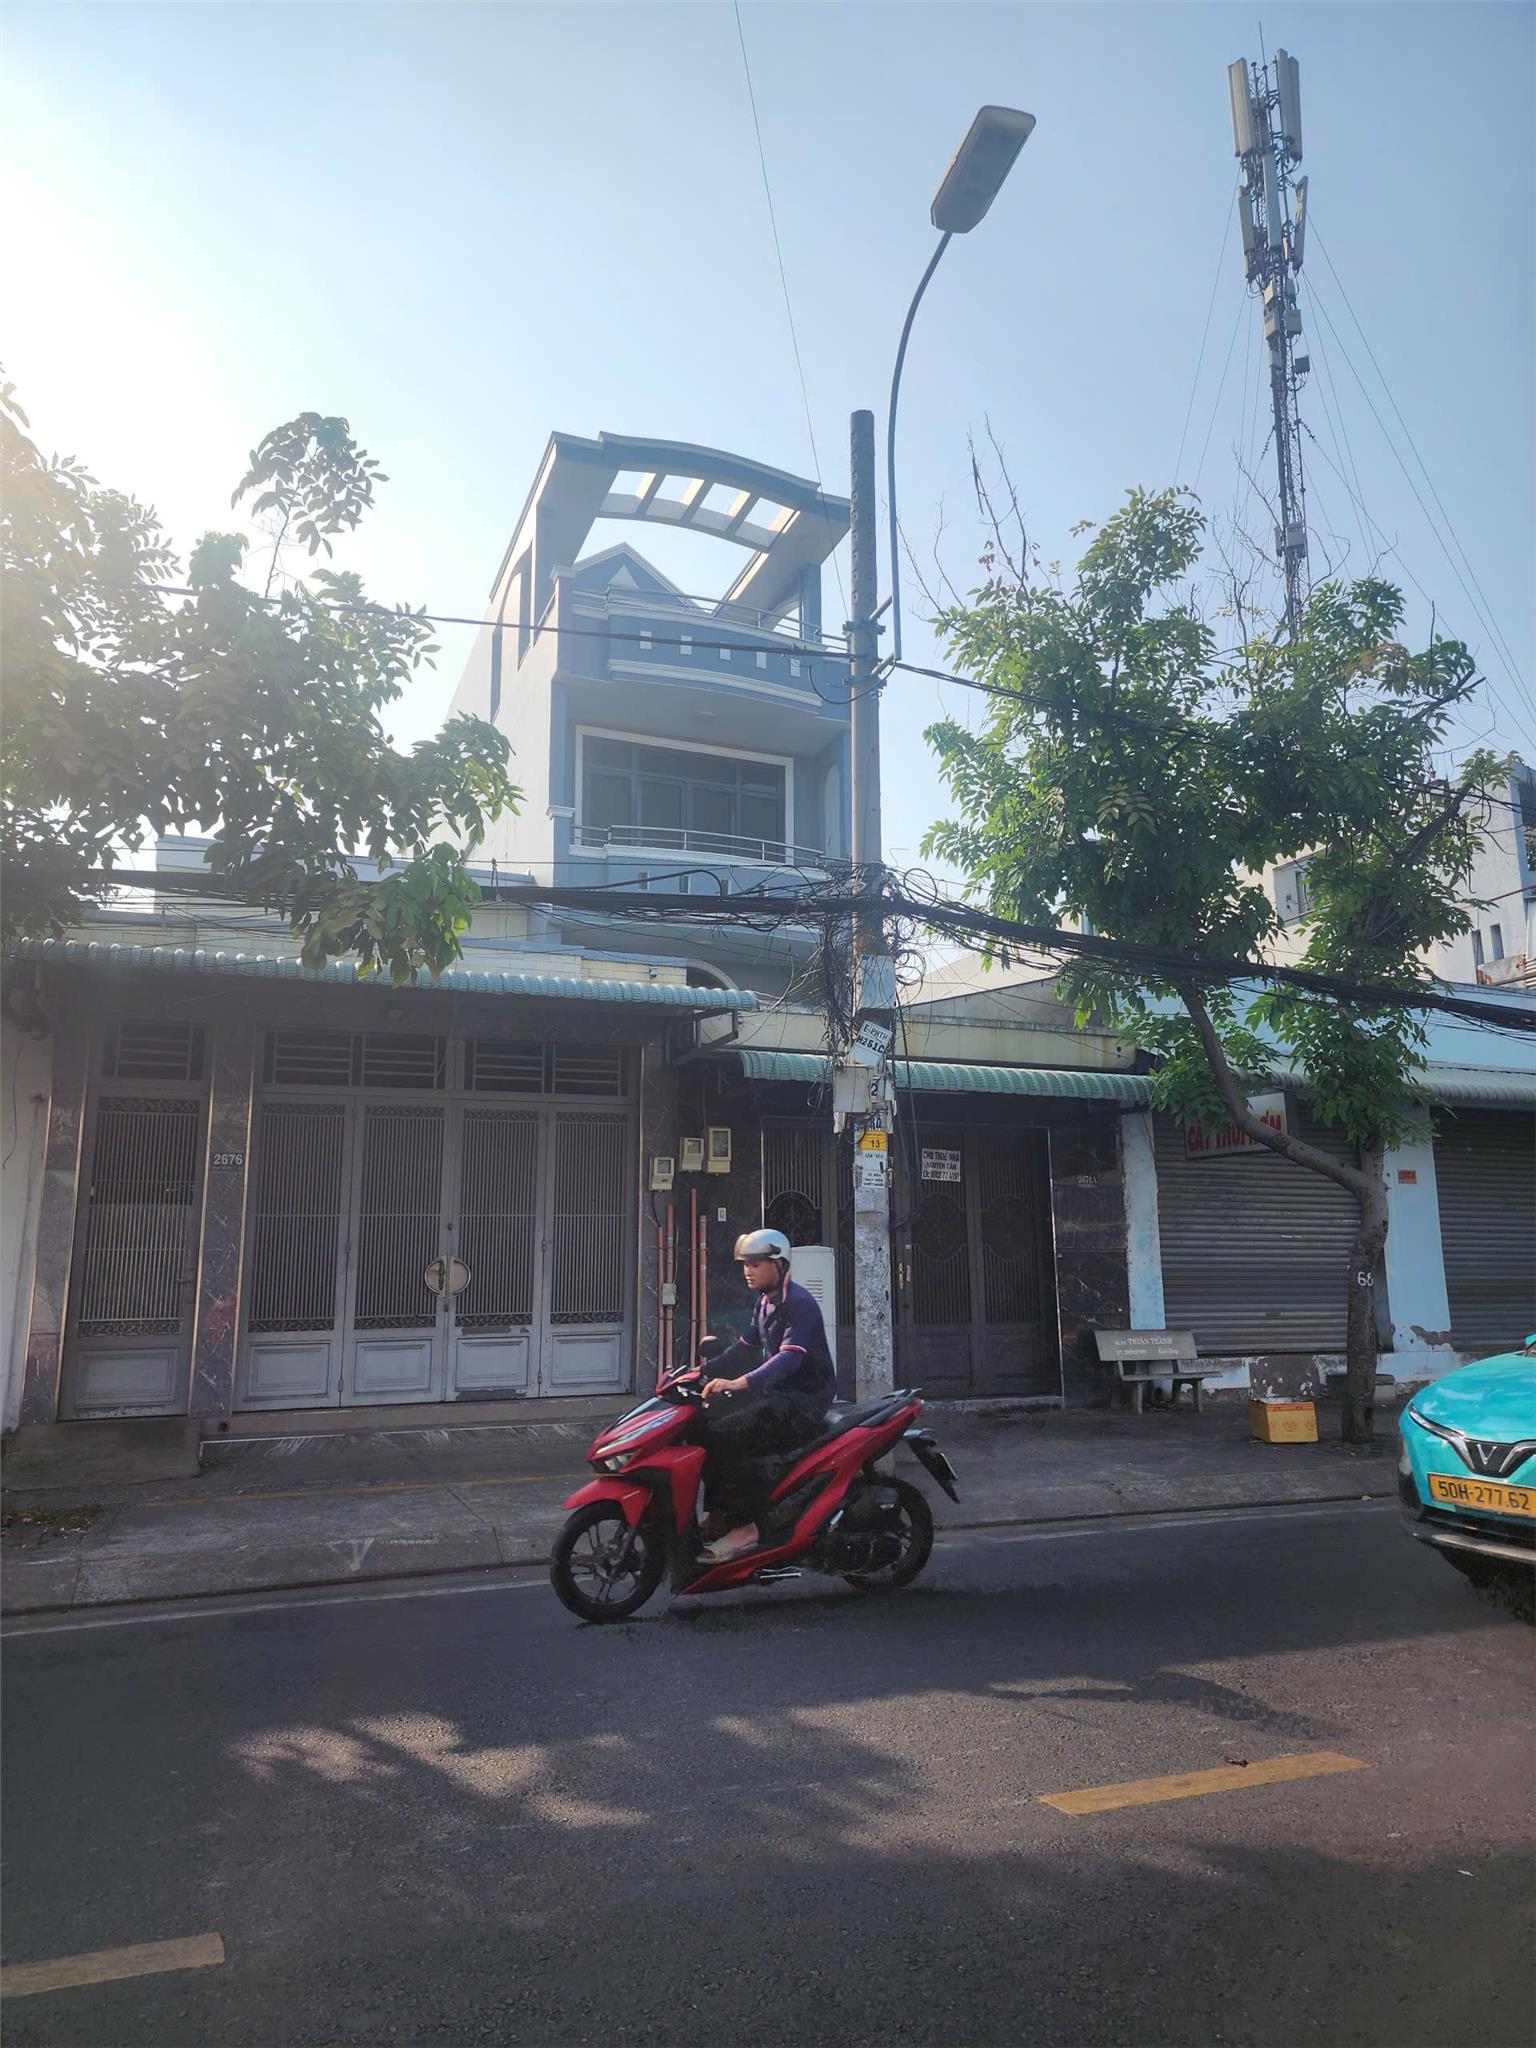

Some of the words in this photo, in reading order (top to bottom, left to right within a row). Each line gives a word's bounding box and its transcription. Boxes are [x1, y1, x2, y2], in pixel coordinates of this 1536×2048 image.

[871, 1139, 881, 1149] 13
[213, 1153, 243, 1165] 2676
[1438, 1480, 1531, 1511] 50H-277.62
